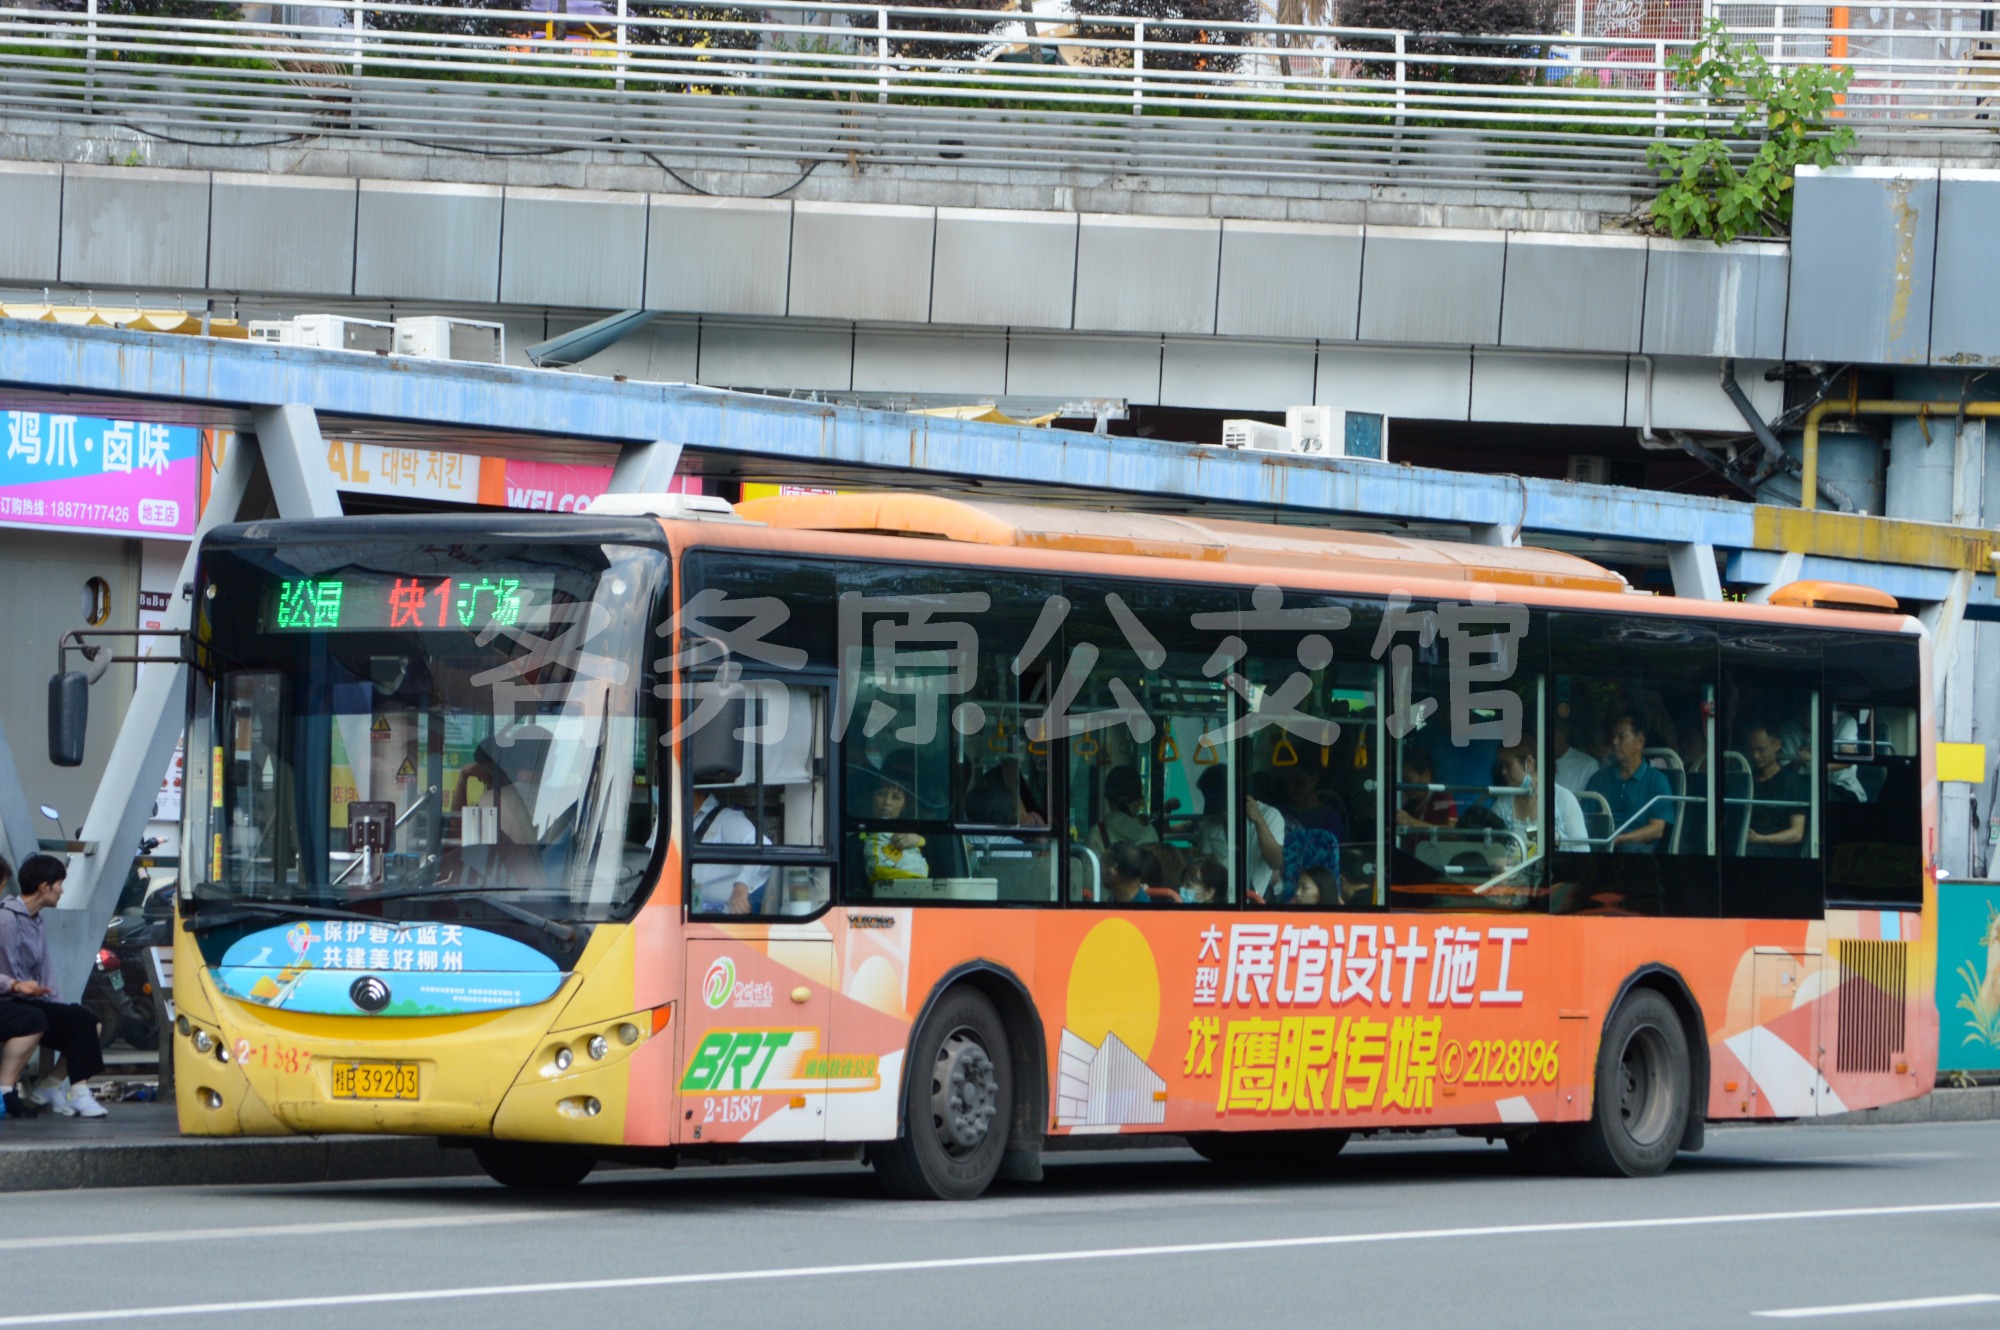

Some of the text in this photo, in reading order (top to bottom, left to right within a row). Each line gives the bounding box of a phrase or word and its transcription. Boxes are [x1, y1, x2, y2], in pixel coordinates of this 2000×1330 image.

[381, 448, 463, 490] 대박 치킨
[142, 503, 175, 523] 地王店
[507, 487, 598, 513] WELCO
[323, 920, 463, 947] 保护碧水蓝天
[323, 946, 463, 973] 共建美好柳州
[1222, 923, 1529, 1004] 展馆设计施工
[680, 1032, 794, 1090] BRT
[1462, 1039, 1560, 1083] 2128196
[703, 1095, 762, 1123] 2-1587
